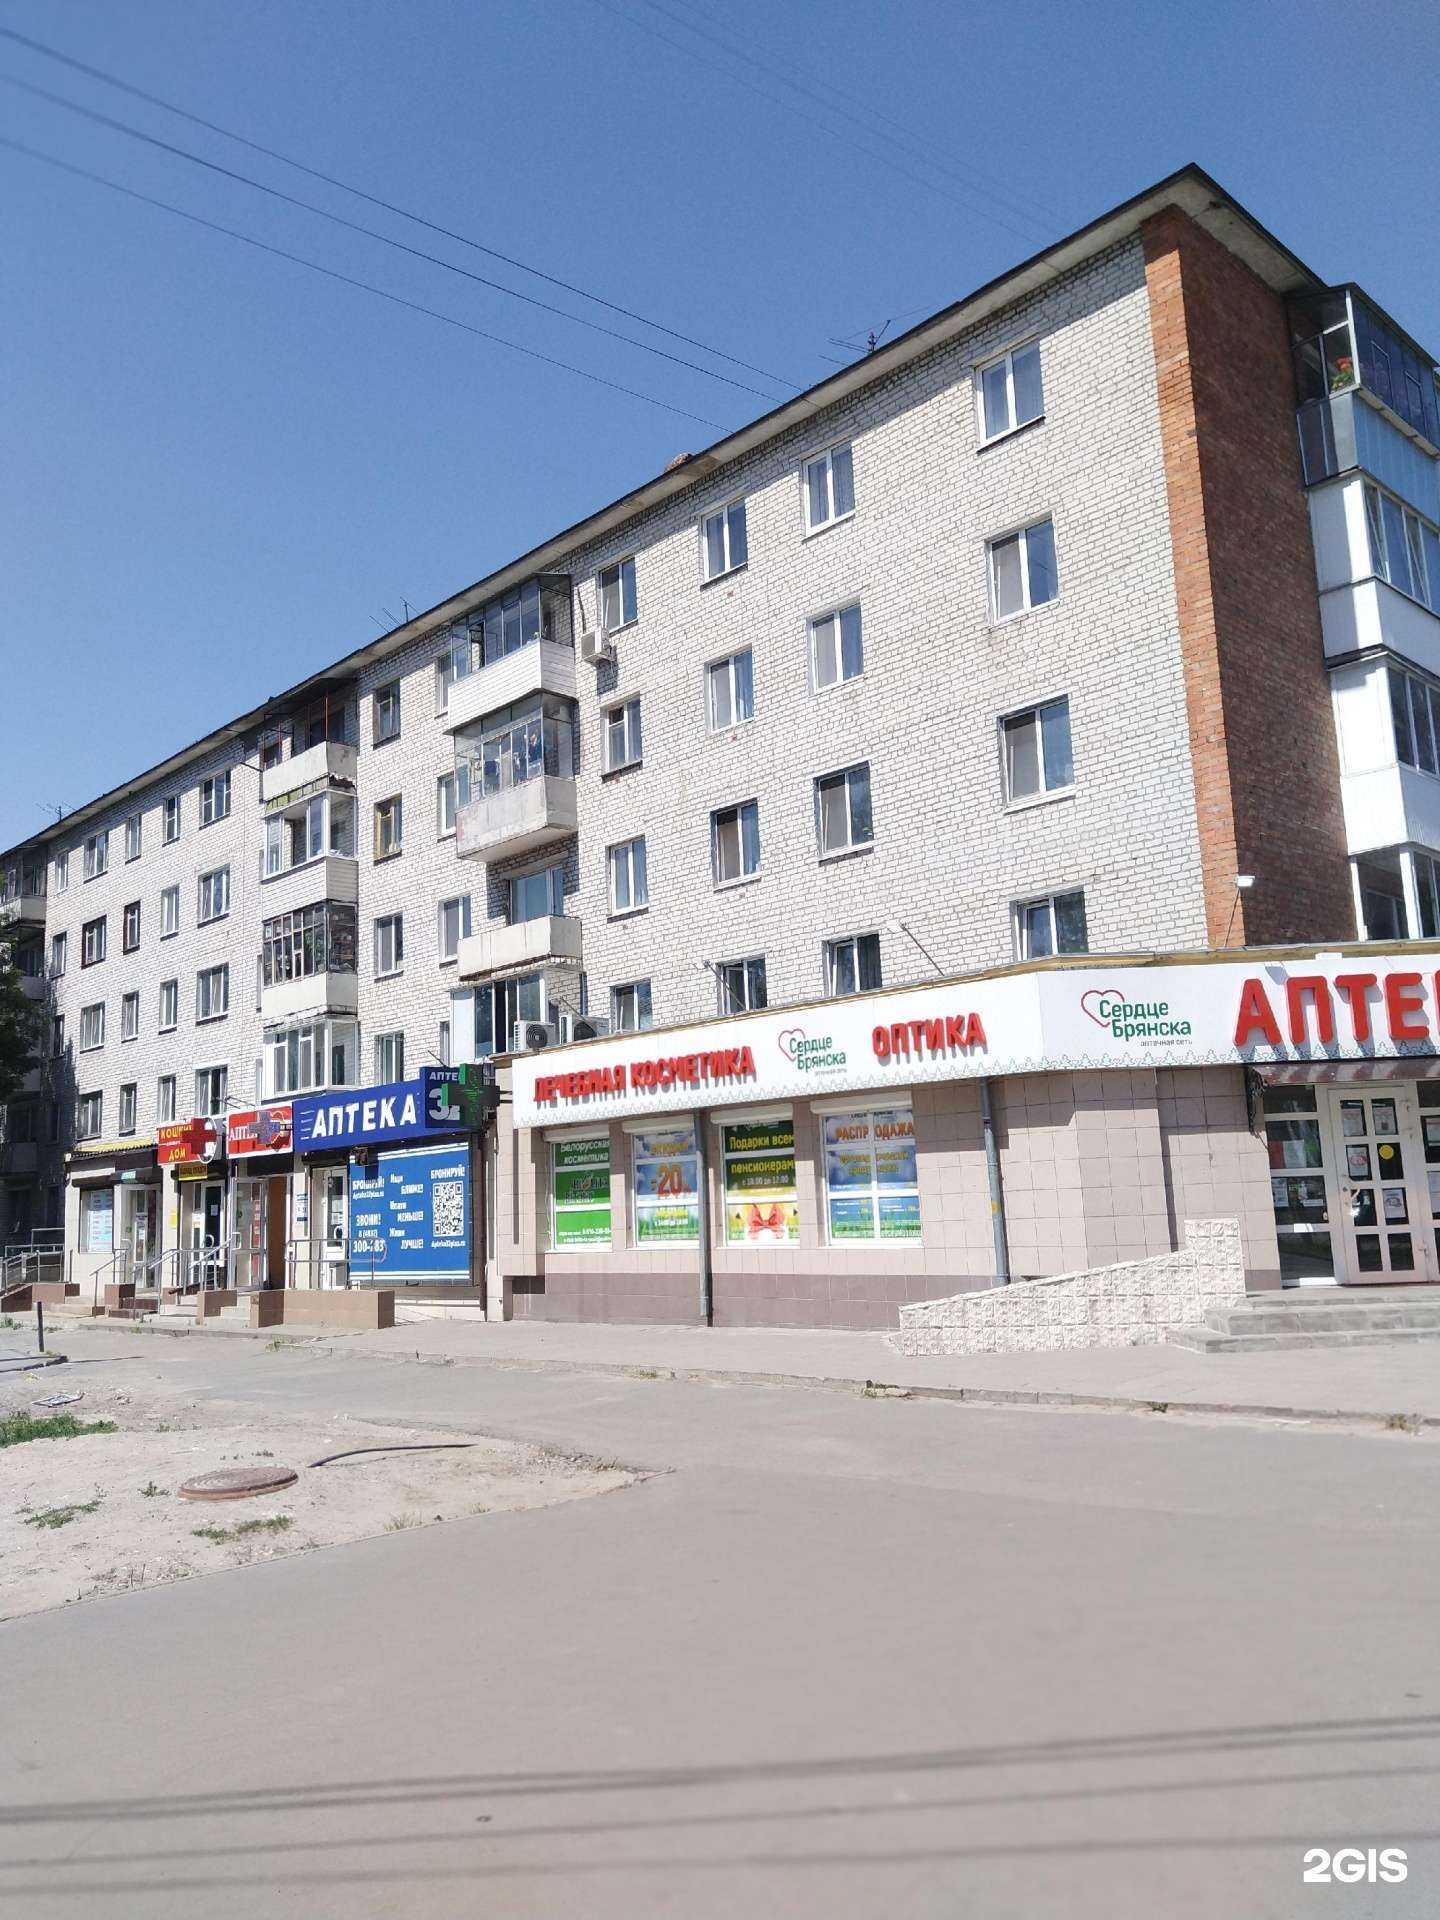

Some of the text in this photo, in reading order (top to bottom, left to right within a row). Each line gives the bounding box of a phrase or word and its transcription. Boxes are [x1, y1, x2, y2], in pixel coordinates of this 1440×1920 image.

[1099, 999, 1169, 1020] Сердце
[871, 1012, 987, 1058] ОПТИКА
[1111, 1018, 1192, 1042] Брянска
[789, 1036, 833, 1055] Сердце
[797, 1050, 847, 1073] Брянска
[428, 1071, 461, 1082] АПТЕ
[533, 1046, 756, 1102] ЛЕЧЕБНАЯ КОСМЕТИКА
[312, 1094, 417, 1138] АПТЕКА
[729, 1136, 770, 1151] Подарки
[168, 1147, 186, 1162] ДОМ
[563, 1153, 609, 1165] косметика
[431, 1164, 465, 1179] БРОНИРУЙ!
[730, 1159, 795, 1175] пенсионерам
